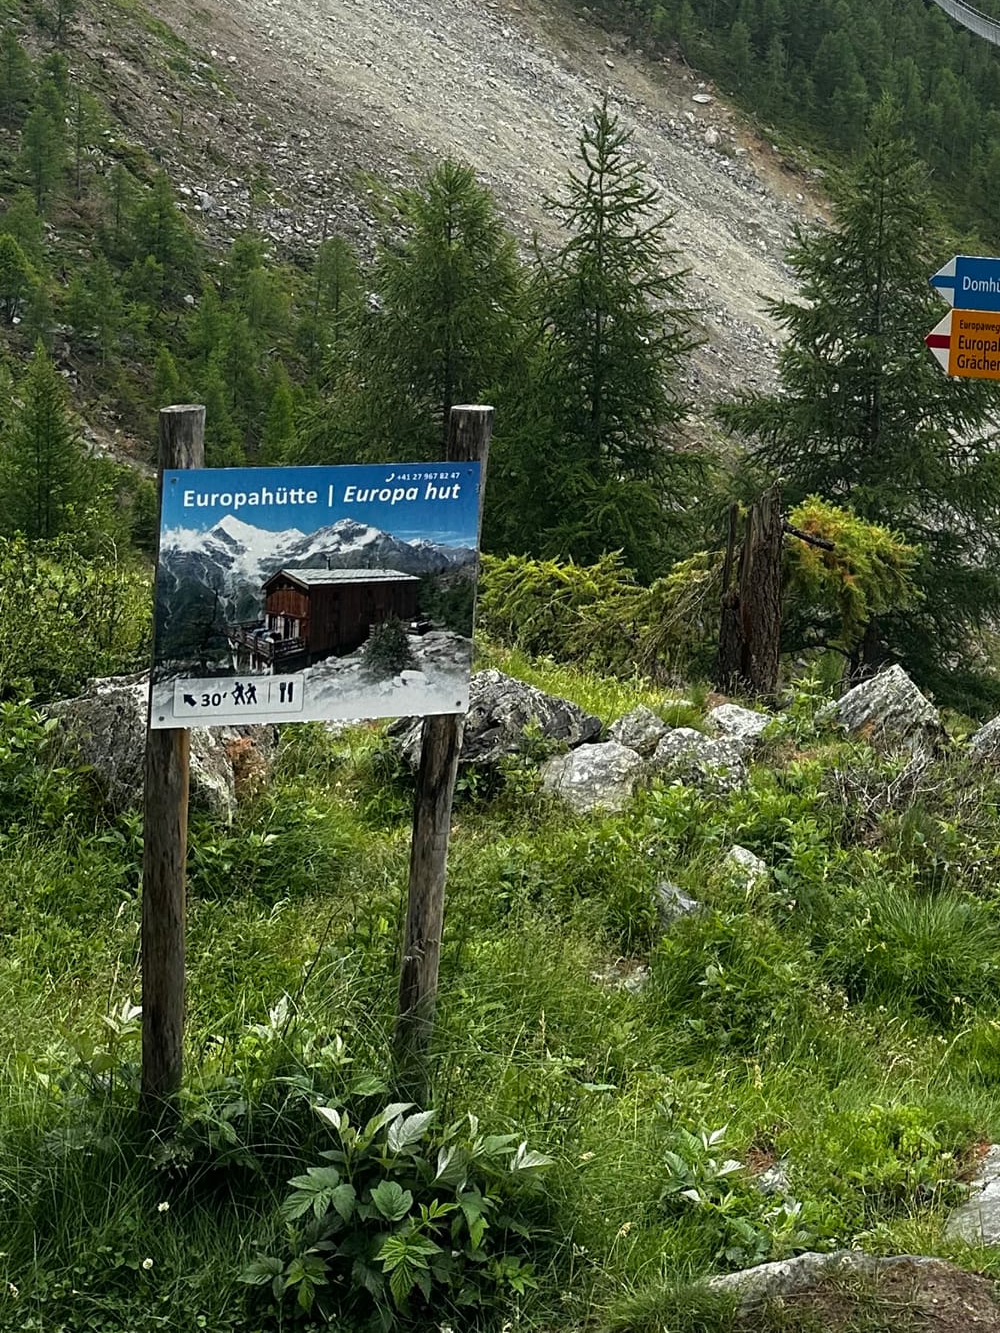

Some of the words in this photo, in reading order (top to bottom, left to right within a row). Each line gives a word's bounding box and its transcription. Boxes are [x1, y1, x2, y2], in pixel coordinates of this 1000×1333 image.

[959, 320, 1000, 334] Europaweg
[183, 488, 318, 510] Europahütte
[343, 486, 418, 505] Europa
[425, 483, 461, 500] hut
